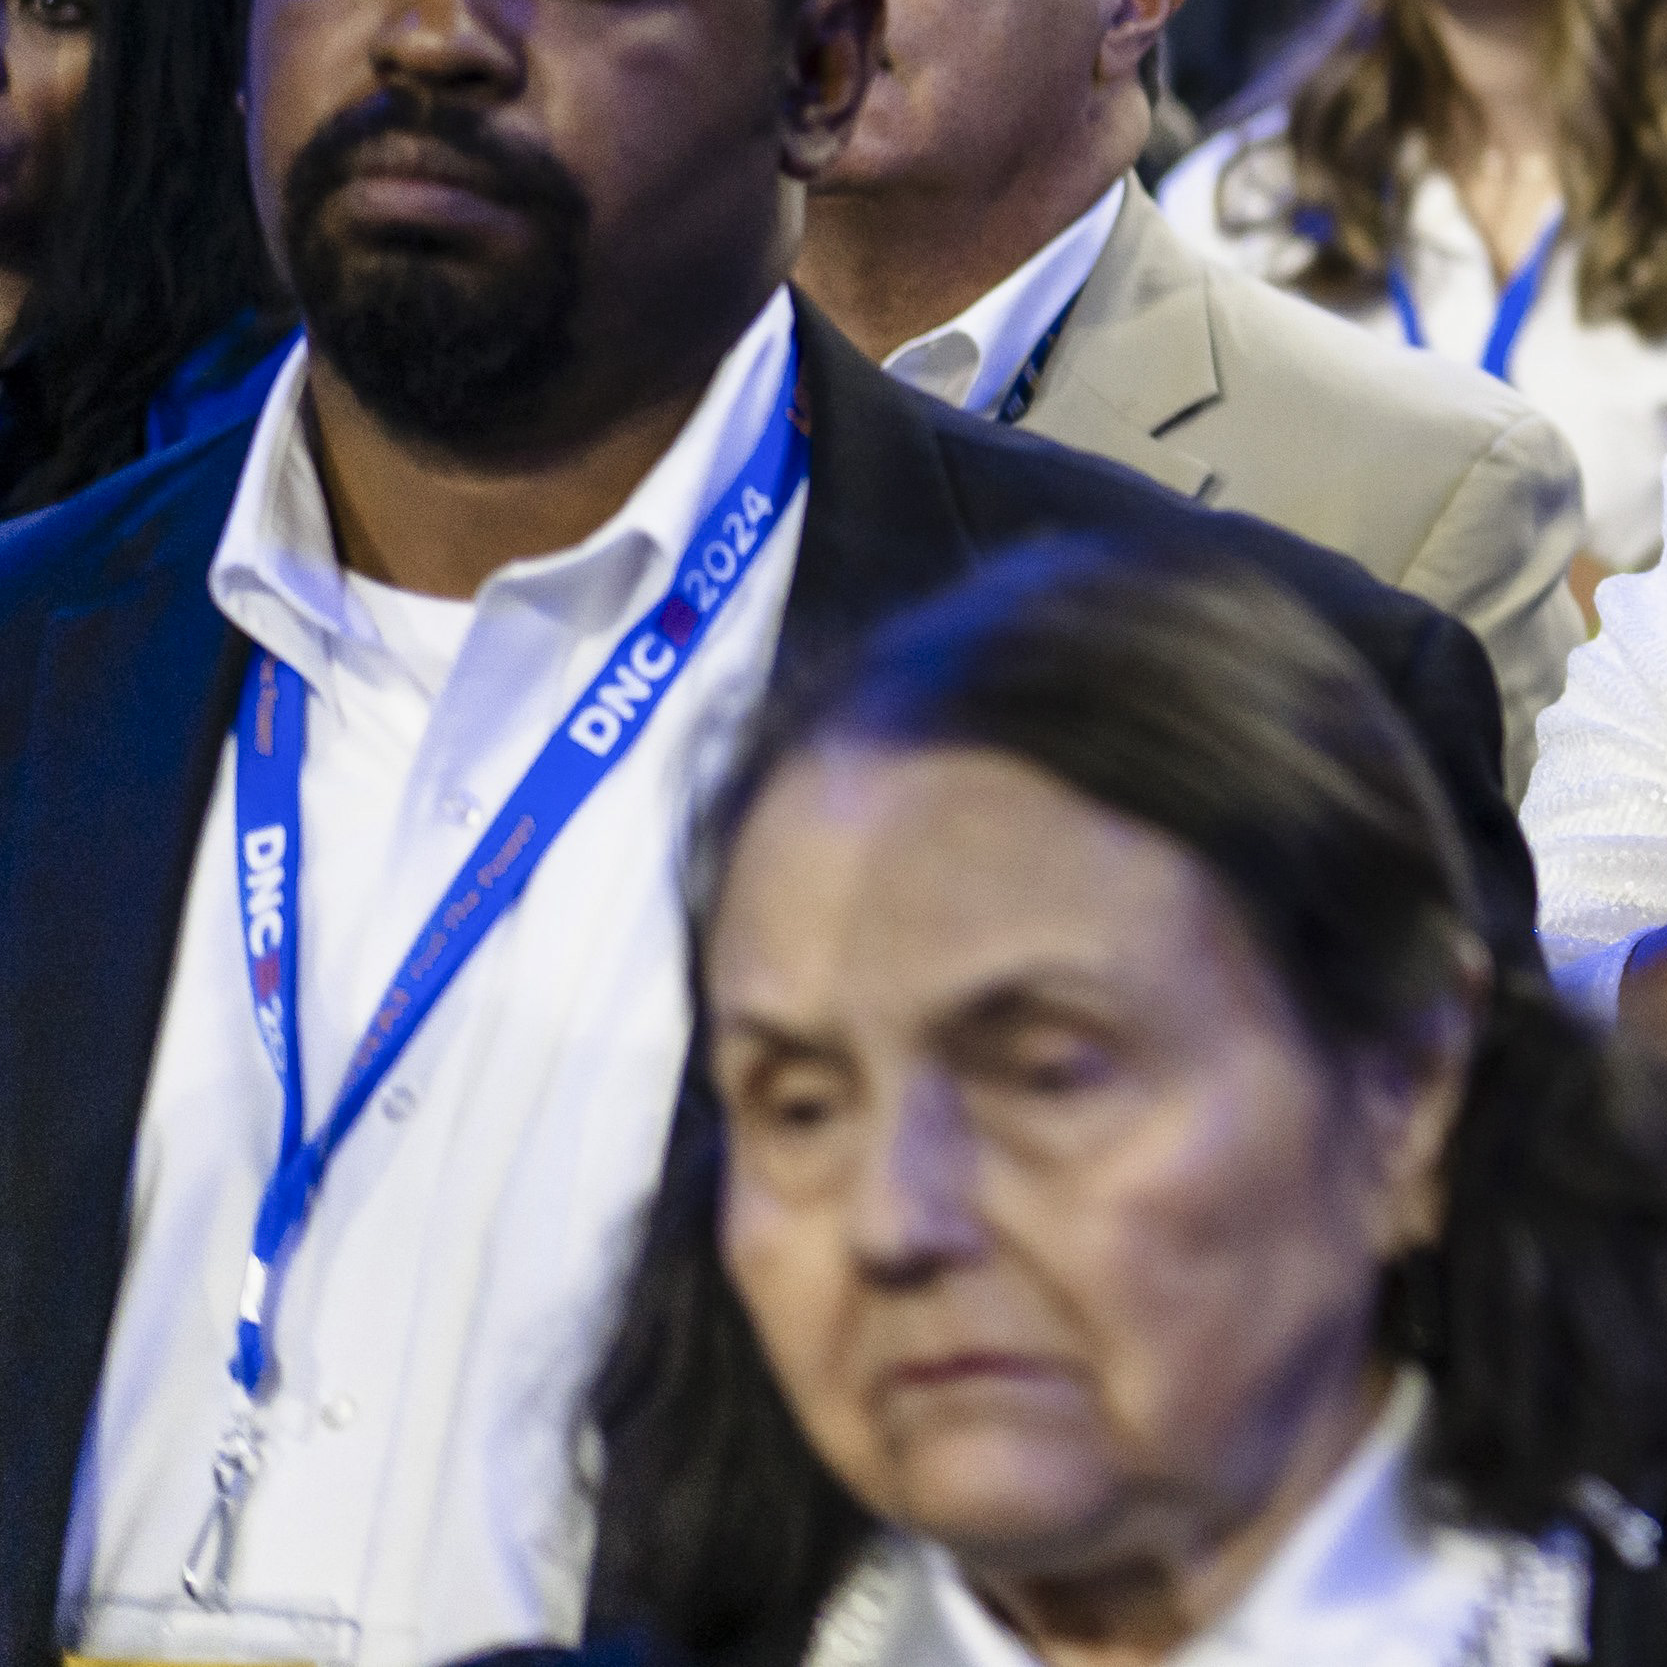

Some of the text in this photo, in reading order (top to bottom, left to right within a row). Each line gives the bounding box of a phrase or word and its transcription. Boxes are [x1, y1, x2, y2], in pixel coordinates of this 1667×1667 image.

[568, 485, 774, 758] DNC 2024
[243, 823, 286, 959] DNC
